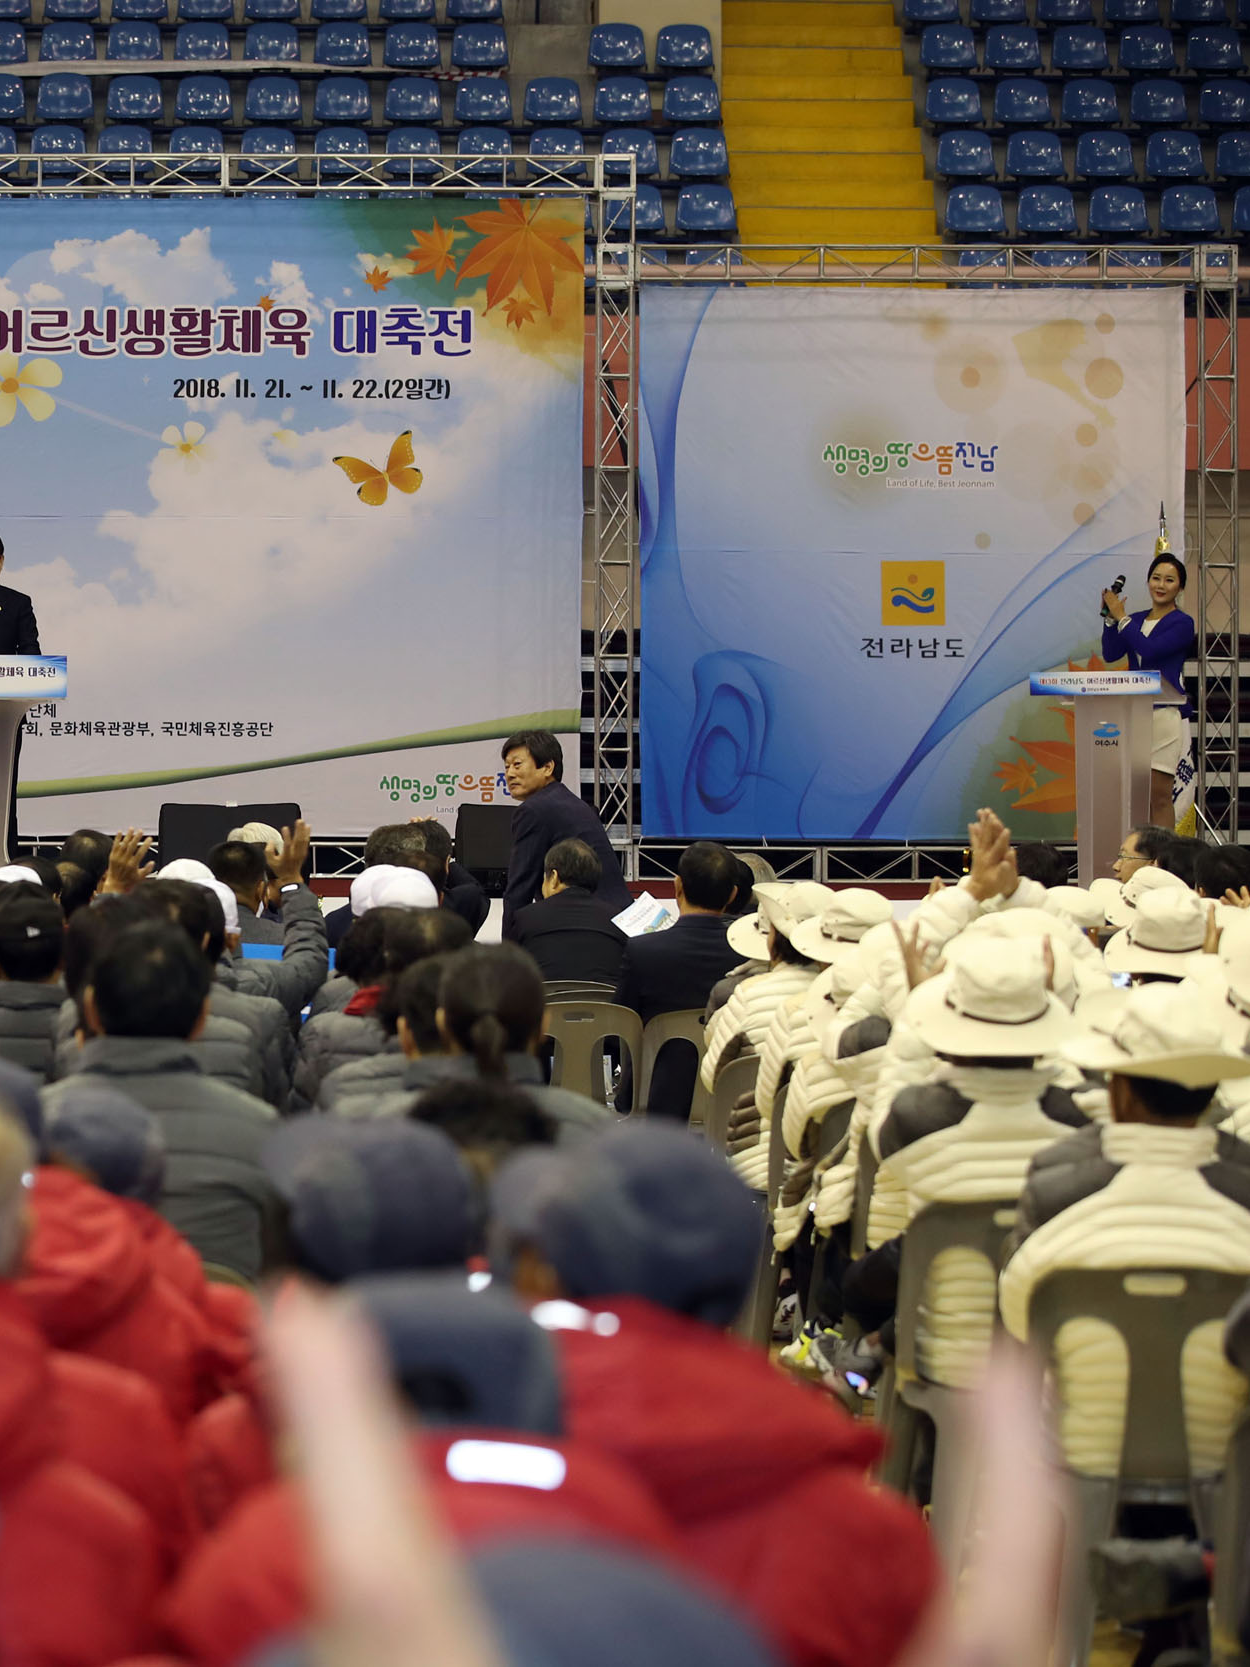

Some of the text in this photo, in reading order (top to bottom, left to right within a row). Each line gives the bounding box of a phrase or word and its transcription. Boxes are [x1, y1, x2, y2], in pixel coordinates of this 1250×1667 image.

[333, 307, 473, 357] 대축전
[173, 378, 226, 399] 2018.
[235, 378, 256, 399] 11.
[265, 378, 291, 399] 21.
[323, 378, 343, 399] 11.
[887, 479, 907, 488] Land
[909, 479, 918, 488] of
[938, 479, 955, 488] Best
[957, 479, 995, 488] Jeonnam
[860, 637, 966, 659] 전라남도
[28, 666, 56, 678] 대축전
[49, 721, 154, 738] 문화체육관광부,
[161, 721, 274, 737] 국민체육진흥공단
